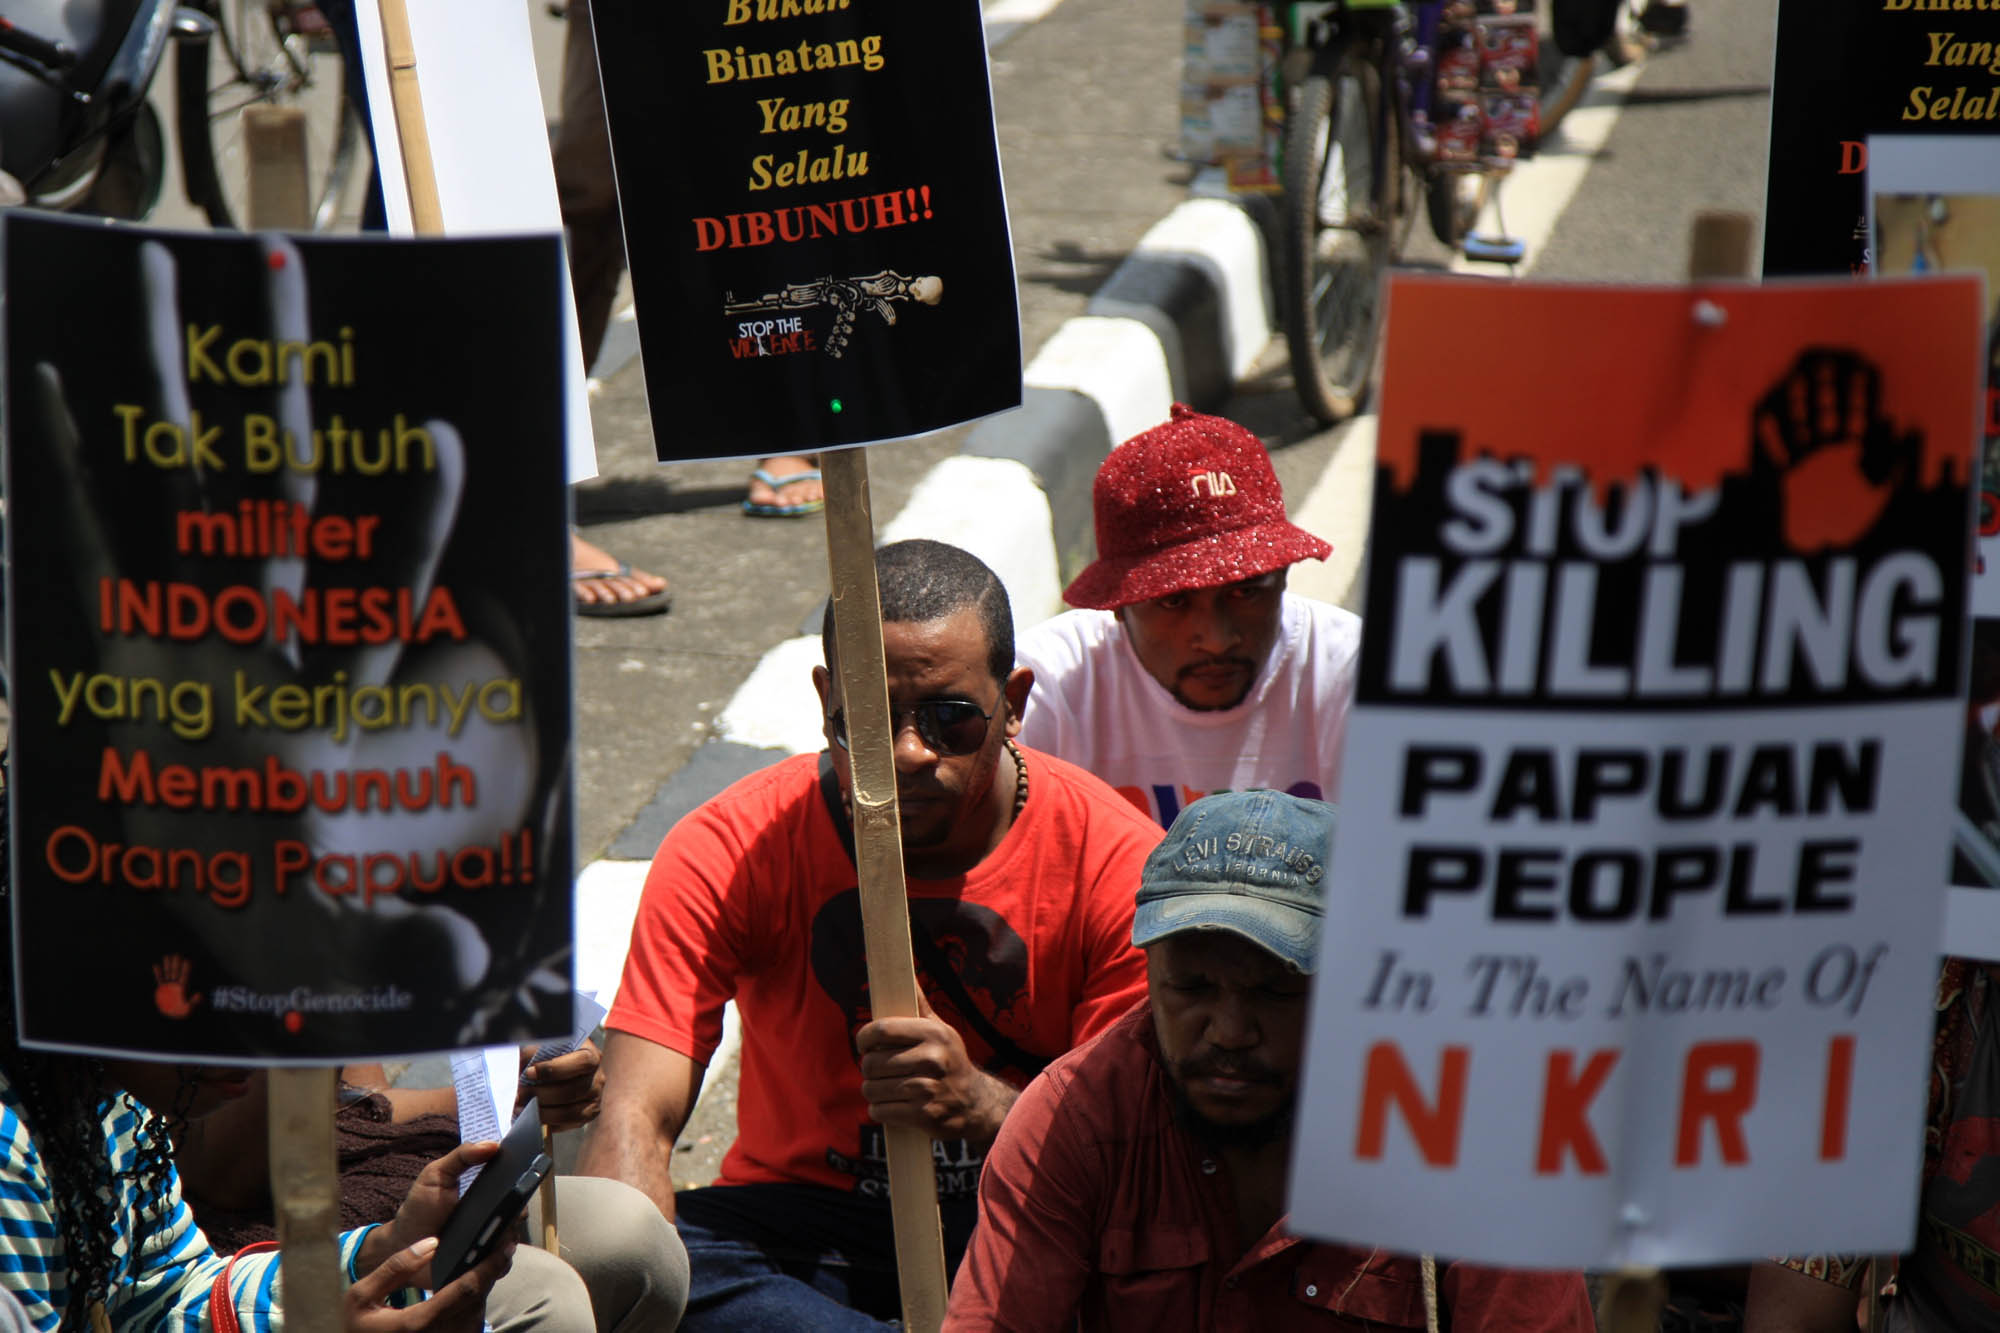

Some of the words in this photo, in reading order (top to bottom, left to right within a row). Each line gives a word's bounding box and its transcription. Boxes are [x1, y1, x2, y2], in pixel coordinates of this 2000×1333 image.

[703, 35, 885, 84] Binatang
[757, 97, 850, 134] Yang
[1902, 86, 2000, 120] Selal
[748, 145, 869, 191] Selalu
[693, 186, 933, 251] DIBUNUH!!
[186, 323, 355, 386] Kami
[738, 319, 774, 338] STOP
[776, 317, 803, 334] THE
[114, 403, 226, 472] Tak
[244, 413, 435, 473] Butuh
[176, 501, 379, 558] militer
[1440, 457, 1720, 558] STOP
[100, 577, 466, 643] INDONESIA
[1390, 553, 1943, 695] KILLING
[49, 668, 213, 739] yang
[233, 670, 523, 740] kerjanya
[99, 747, 476, 812] Membunuh
[1398, 741, 1881, 823] PAPUAN
[46, 826, 250, 907] Orang
[274, 829, 535, 906] Papua!!
[1173, 837, 1218, 872] LEVI
[1403, 841, 1859, 923] PEOPLE
[212, 984, 414, 1018] #StopGenocide
[1359, 950, 1437, 1012] In
[1463, 953, 1588, 1020] The
[1608, 951, 1785, 1020] Name
[1802, 943, 1890, 1018] Of
